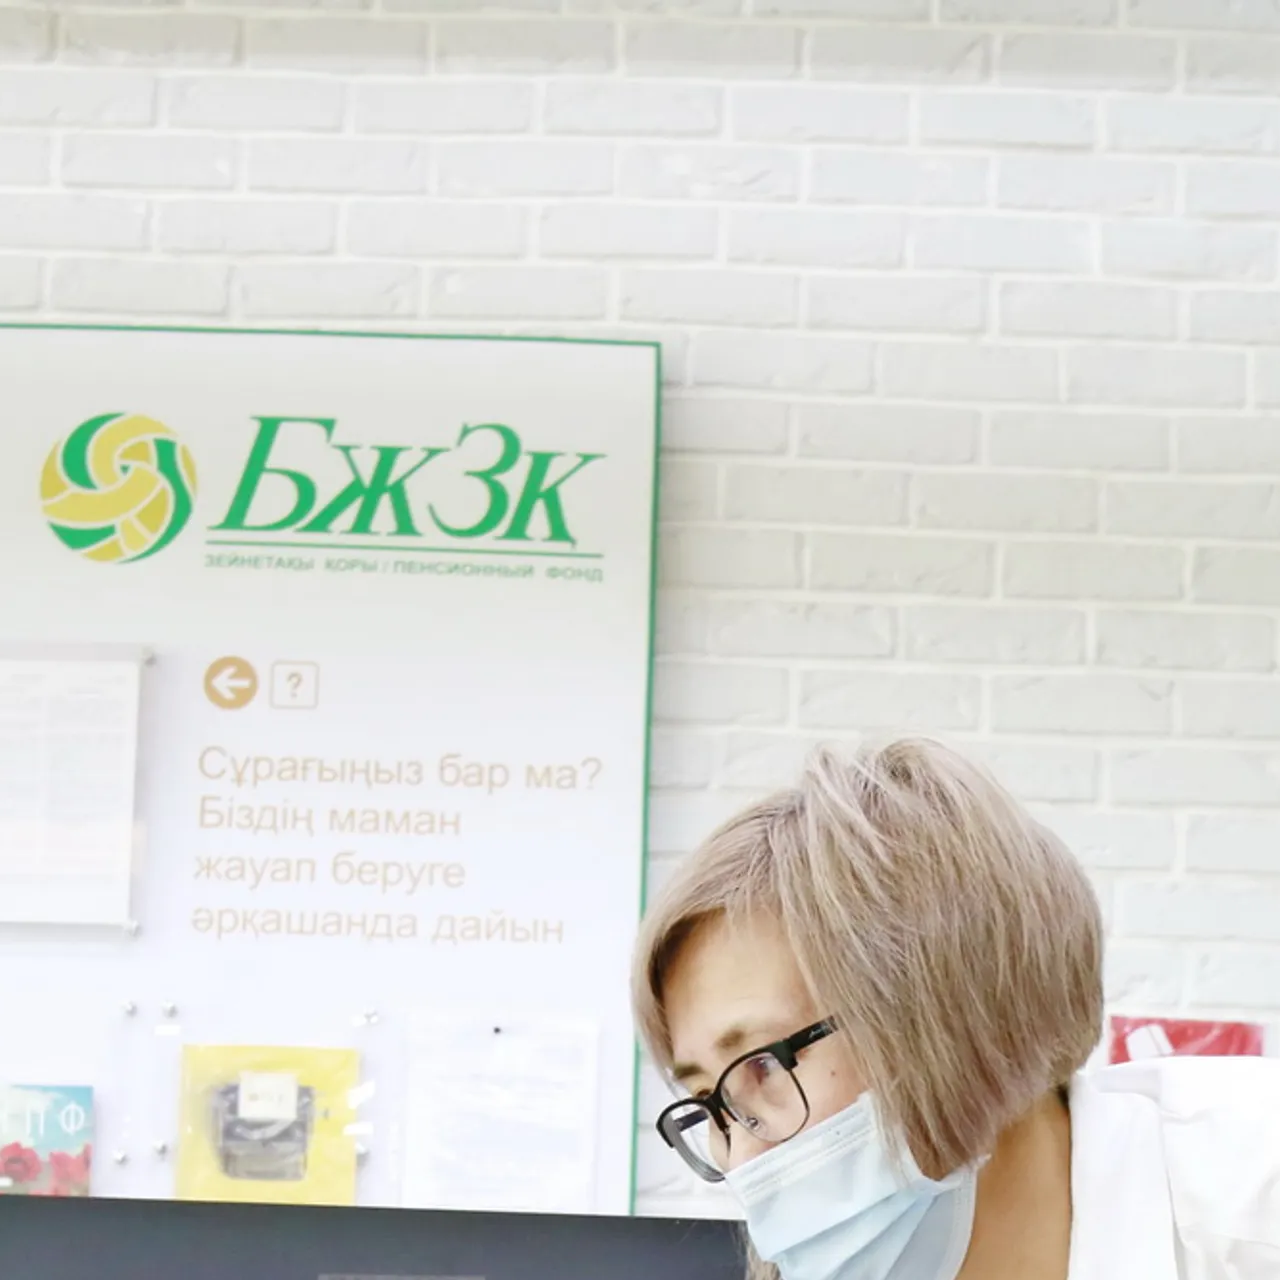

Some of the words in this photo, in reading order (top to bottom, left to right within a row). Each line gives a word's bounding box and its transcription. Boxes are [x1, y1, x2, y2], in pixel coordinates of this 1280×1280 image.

[198, 746, 424, 788] Сұрағыңыз
[438, 753, 510, 795] бар
[524, 757, 603, 790] ма?
[198, 796, 314, 837] Біздің
[328, 807, 462, 836] маман
[193, 853, 317, 890] жауап
[331, 850, 466, 895] беруге
[191, 907, 418, 940] әрқашанда
[431, 910, 564, 945] дайын
